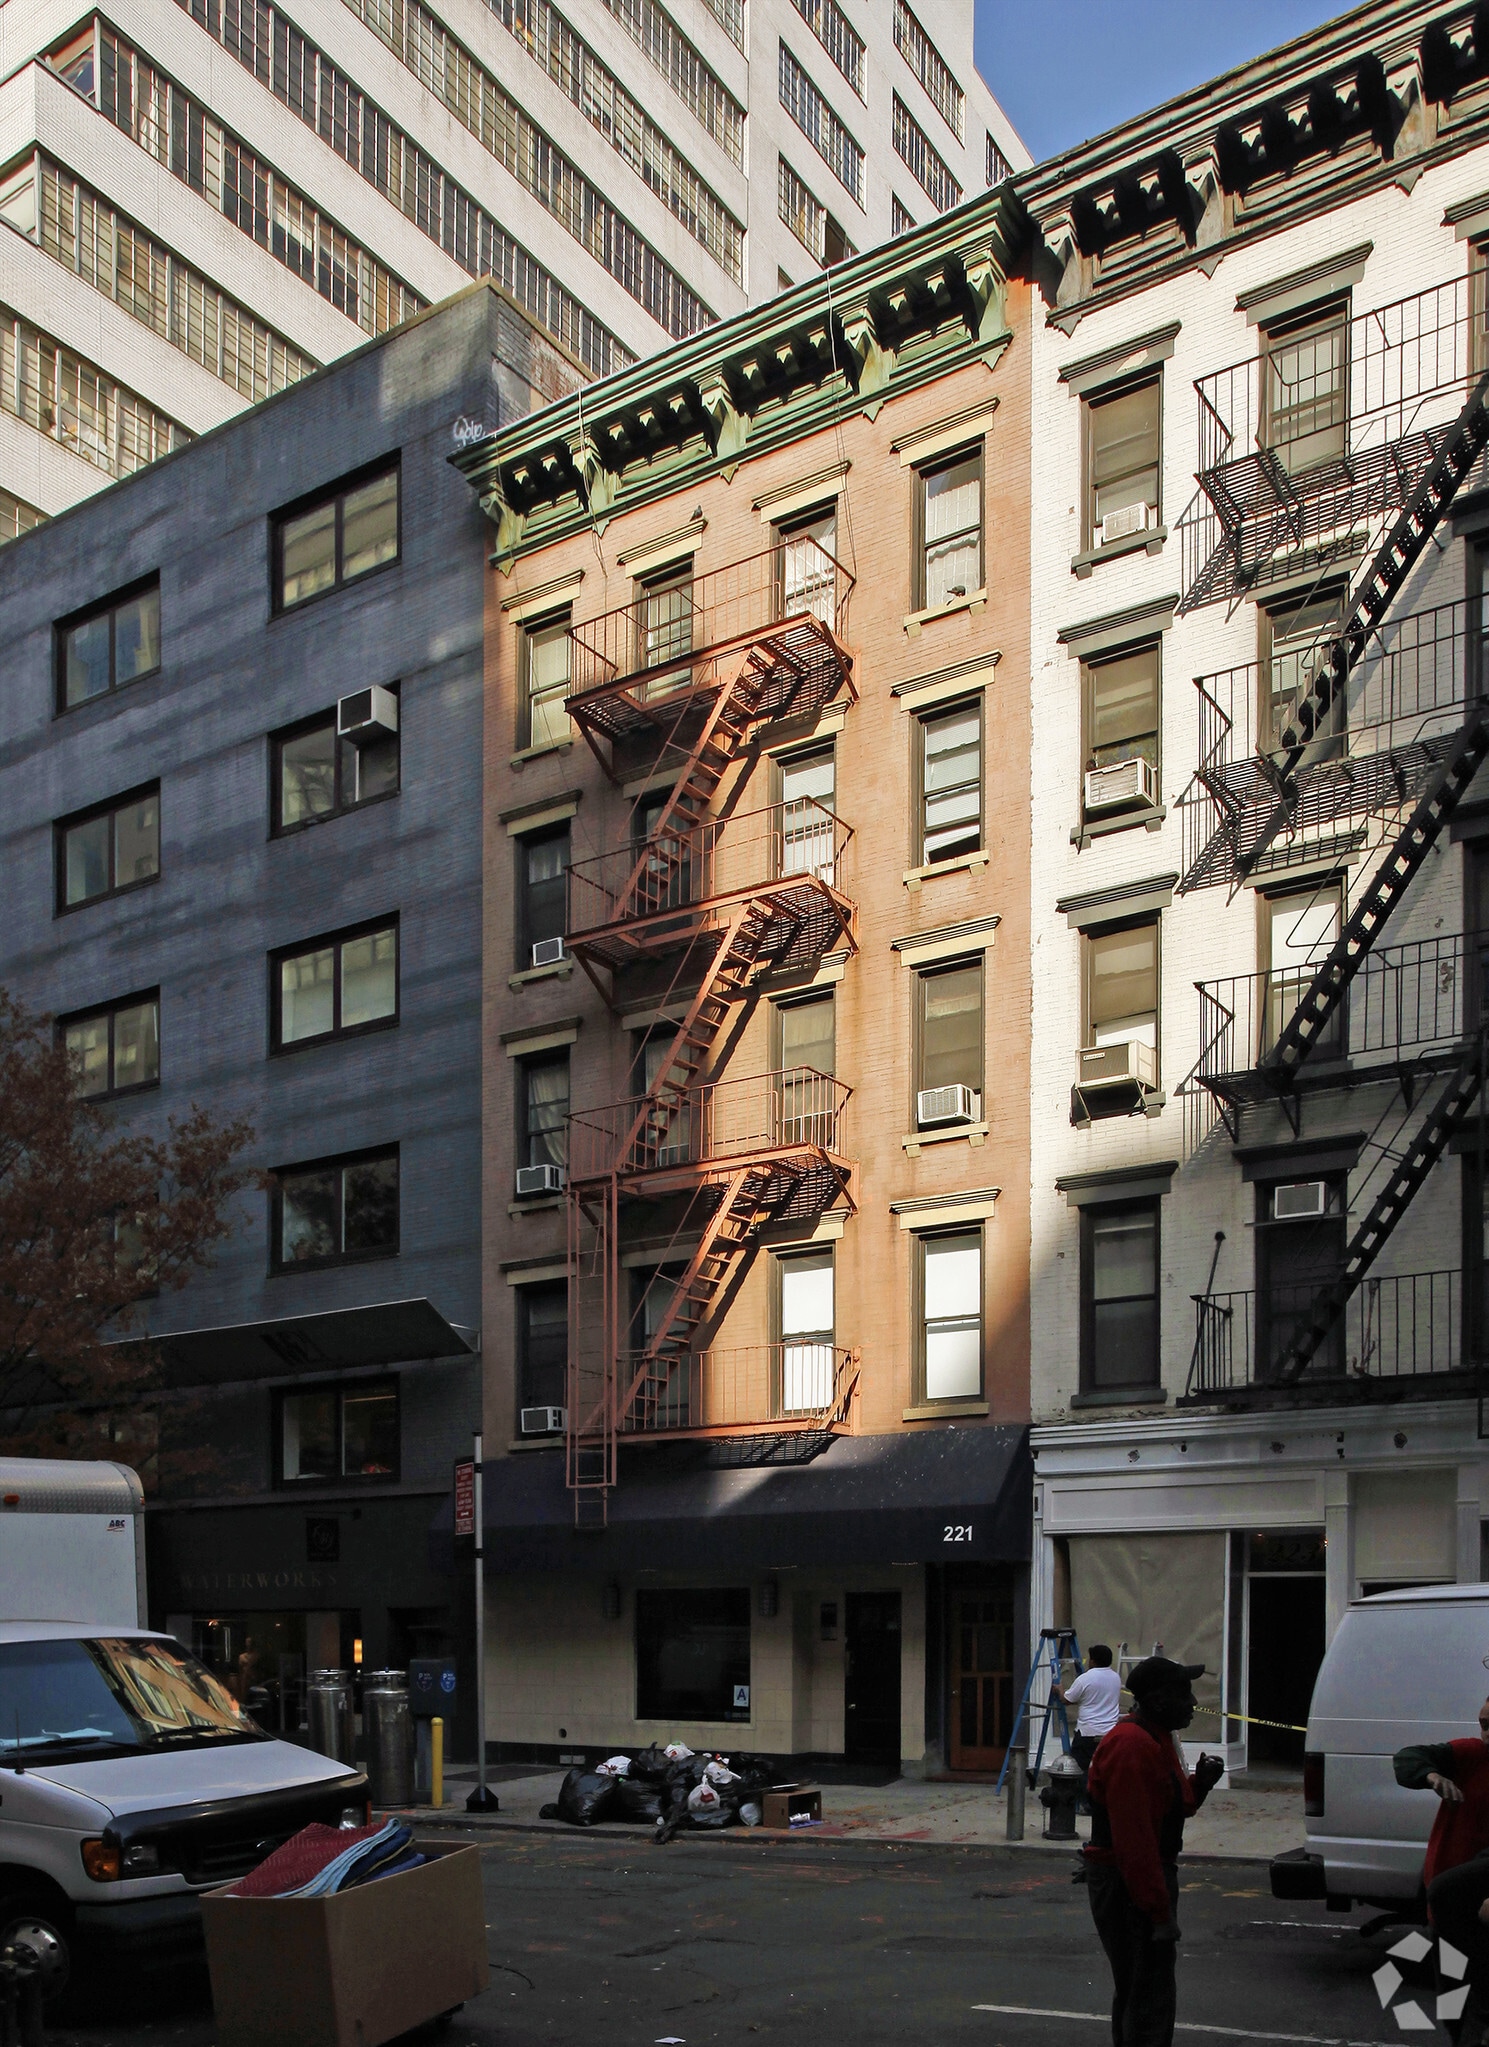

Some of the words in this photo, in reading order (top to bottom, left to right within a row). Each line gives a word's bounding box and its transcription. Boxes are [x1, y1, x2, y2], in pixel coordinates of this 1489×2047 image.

[108, 1519, 126, 1528] ABC
[943, 1525, 973, 1542] 221
[181, 1571, 337, 1589] WATERWORKS
[736, 1687, 747, 1701] A
